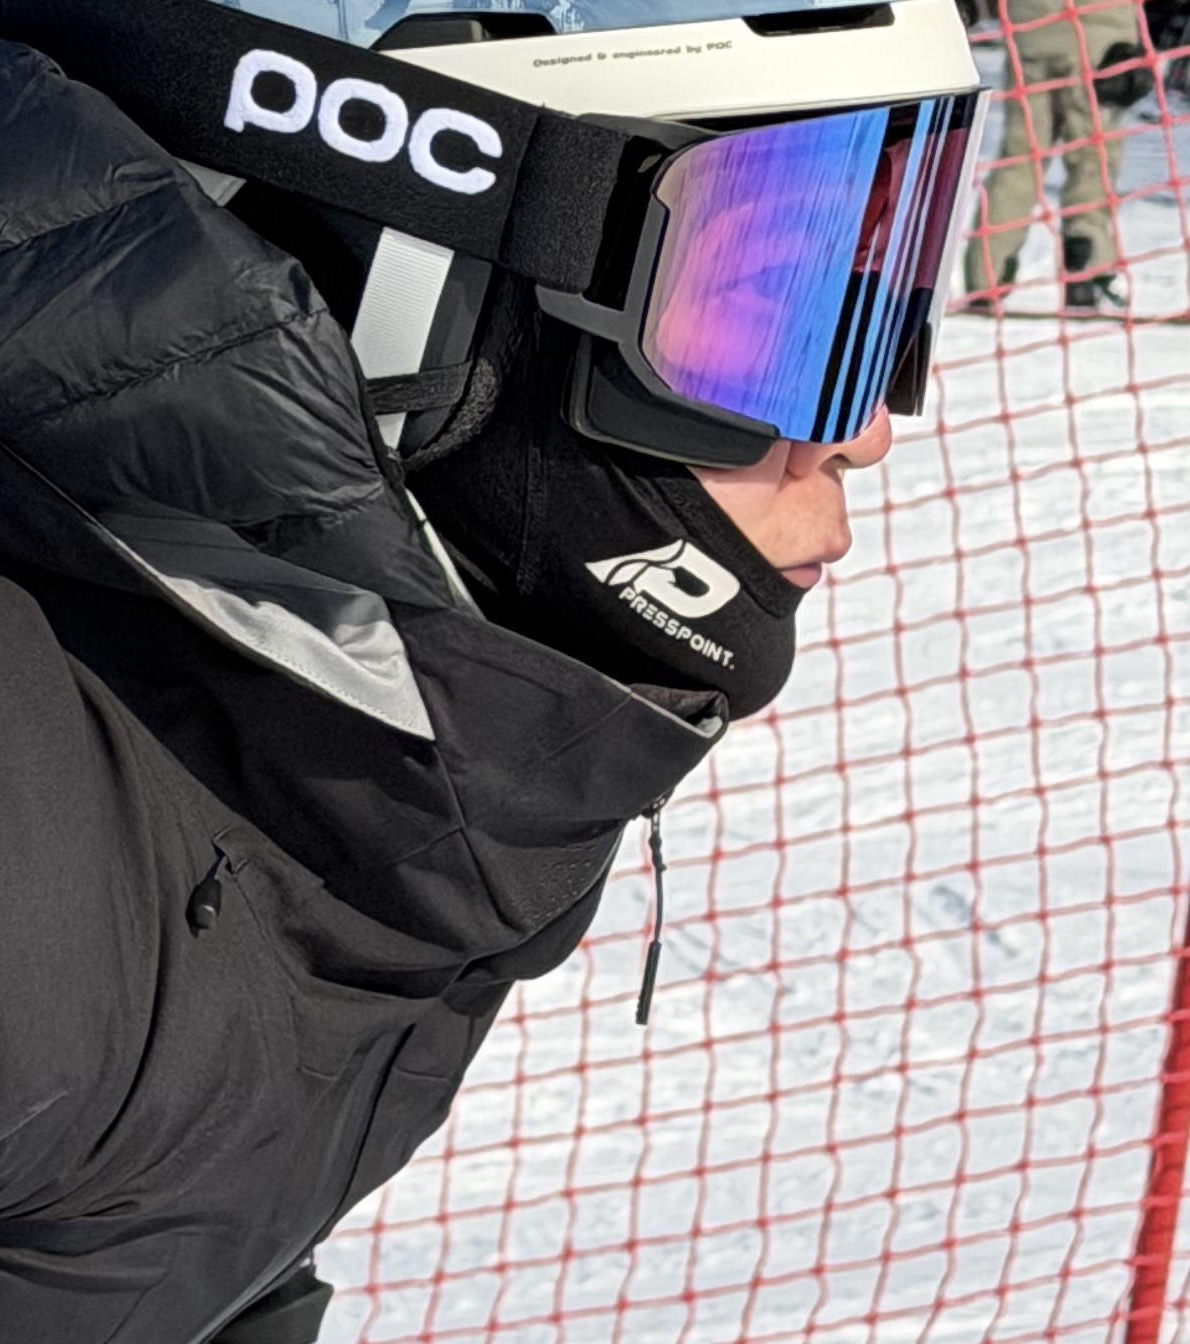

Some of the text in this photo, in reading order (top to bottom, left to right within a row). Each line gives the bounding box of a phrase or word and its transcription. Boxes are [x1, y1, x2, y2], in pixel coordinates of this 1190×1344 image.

[533, 53, 592, 67] Designed
[612, 46, 681, 59] engineered
[686, 45, 702, 53] by
[706, 40, 733, 51] POC
